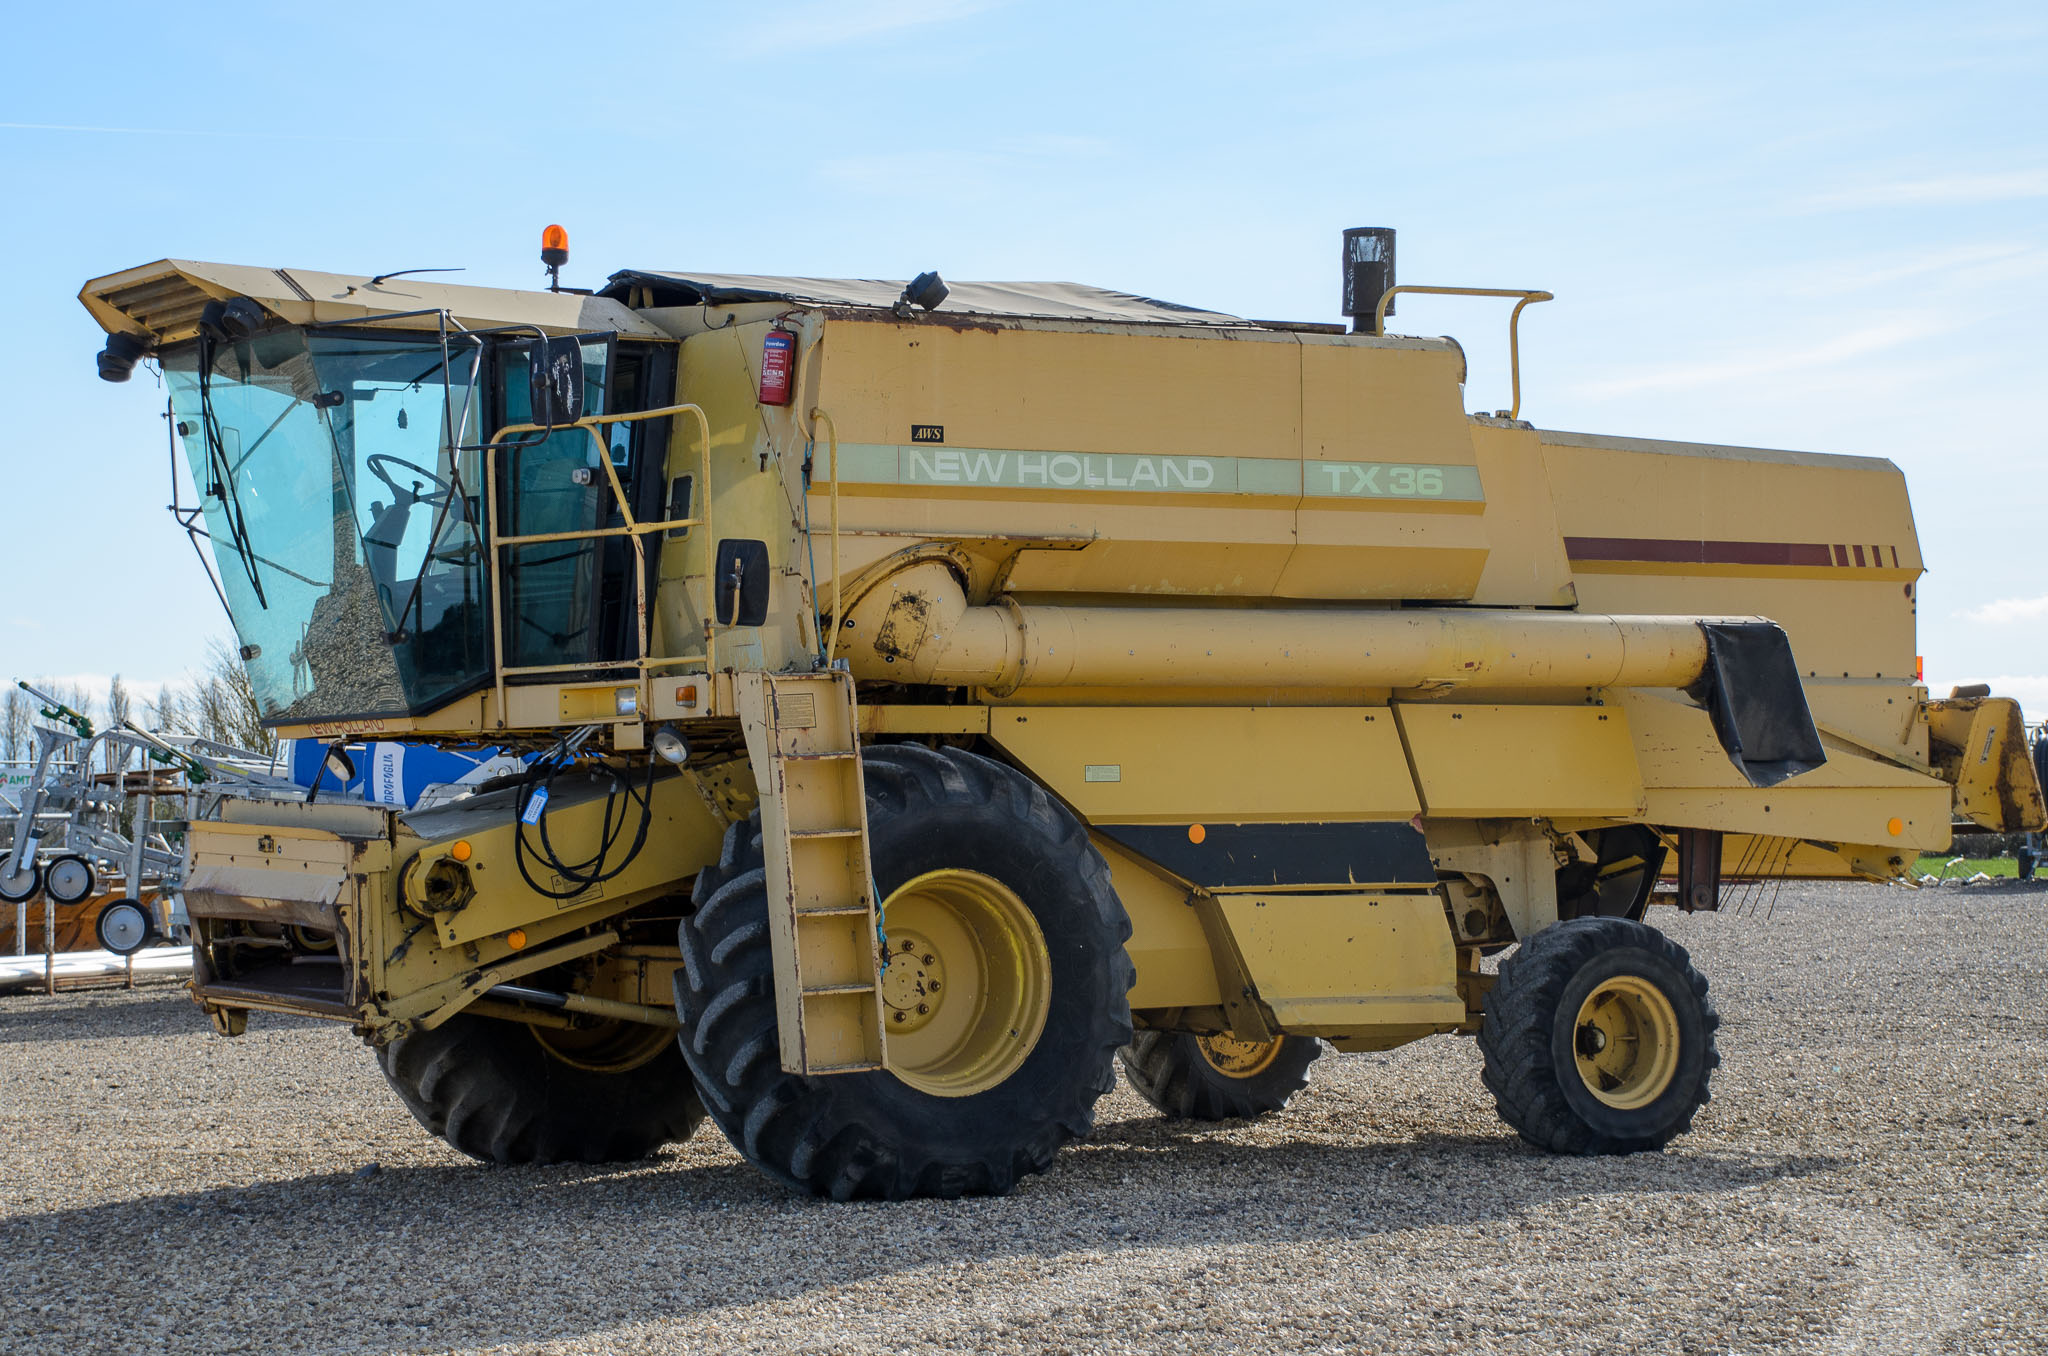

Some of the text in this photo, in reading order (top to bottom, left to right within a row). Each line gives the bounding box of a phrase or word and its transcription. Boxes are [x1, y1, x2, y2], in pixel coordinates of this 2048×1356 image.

[914, 428, 942, 440] AWS
[909, 450, 1214, 488] NEW HOLLAND
[1322, 464, 1443, 495] TX 36
[308, 719, 384, 735] NEW HOLLAND
[9, 775, 33, 784] AMT
